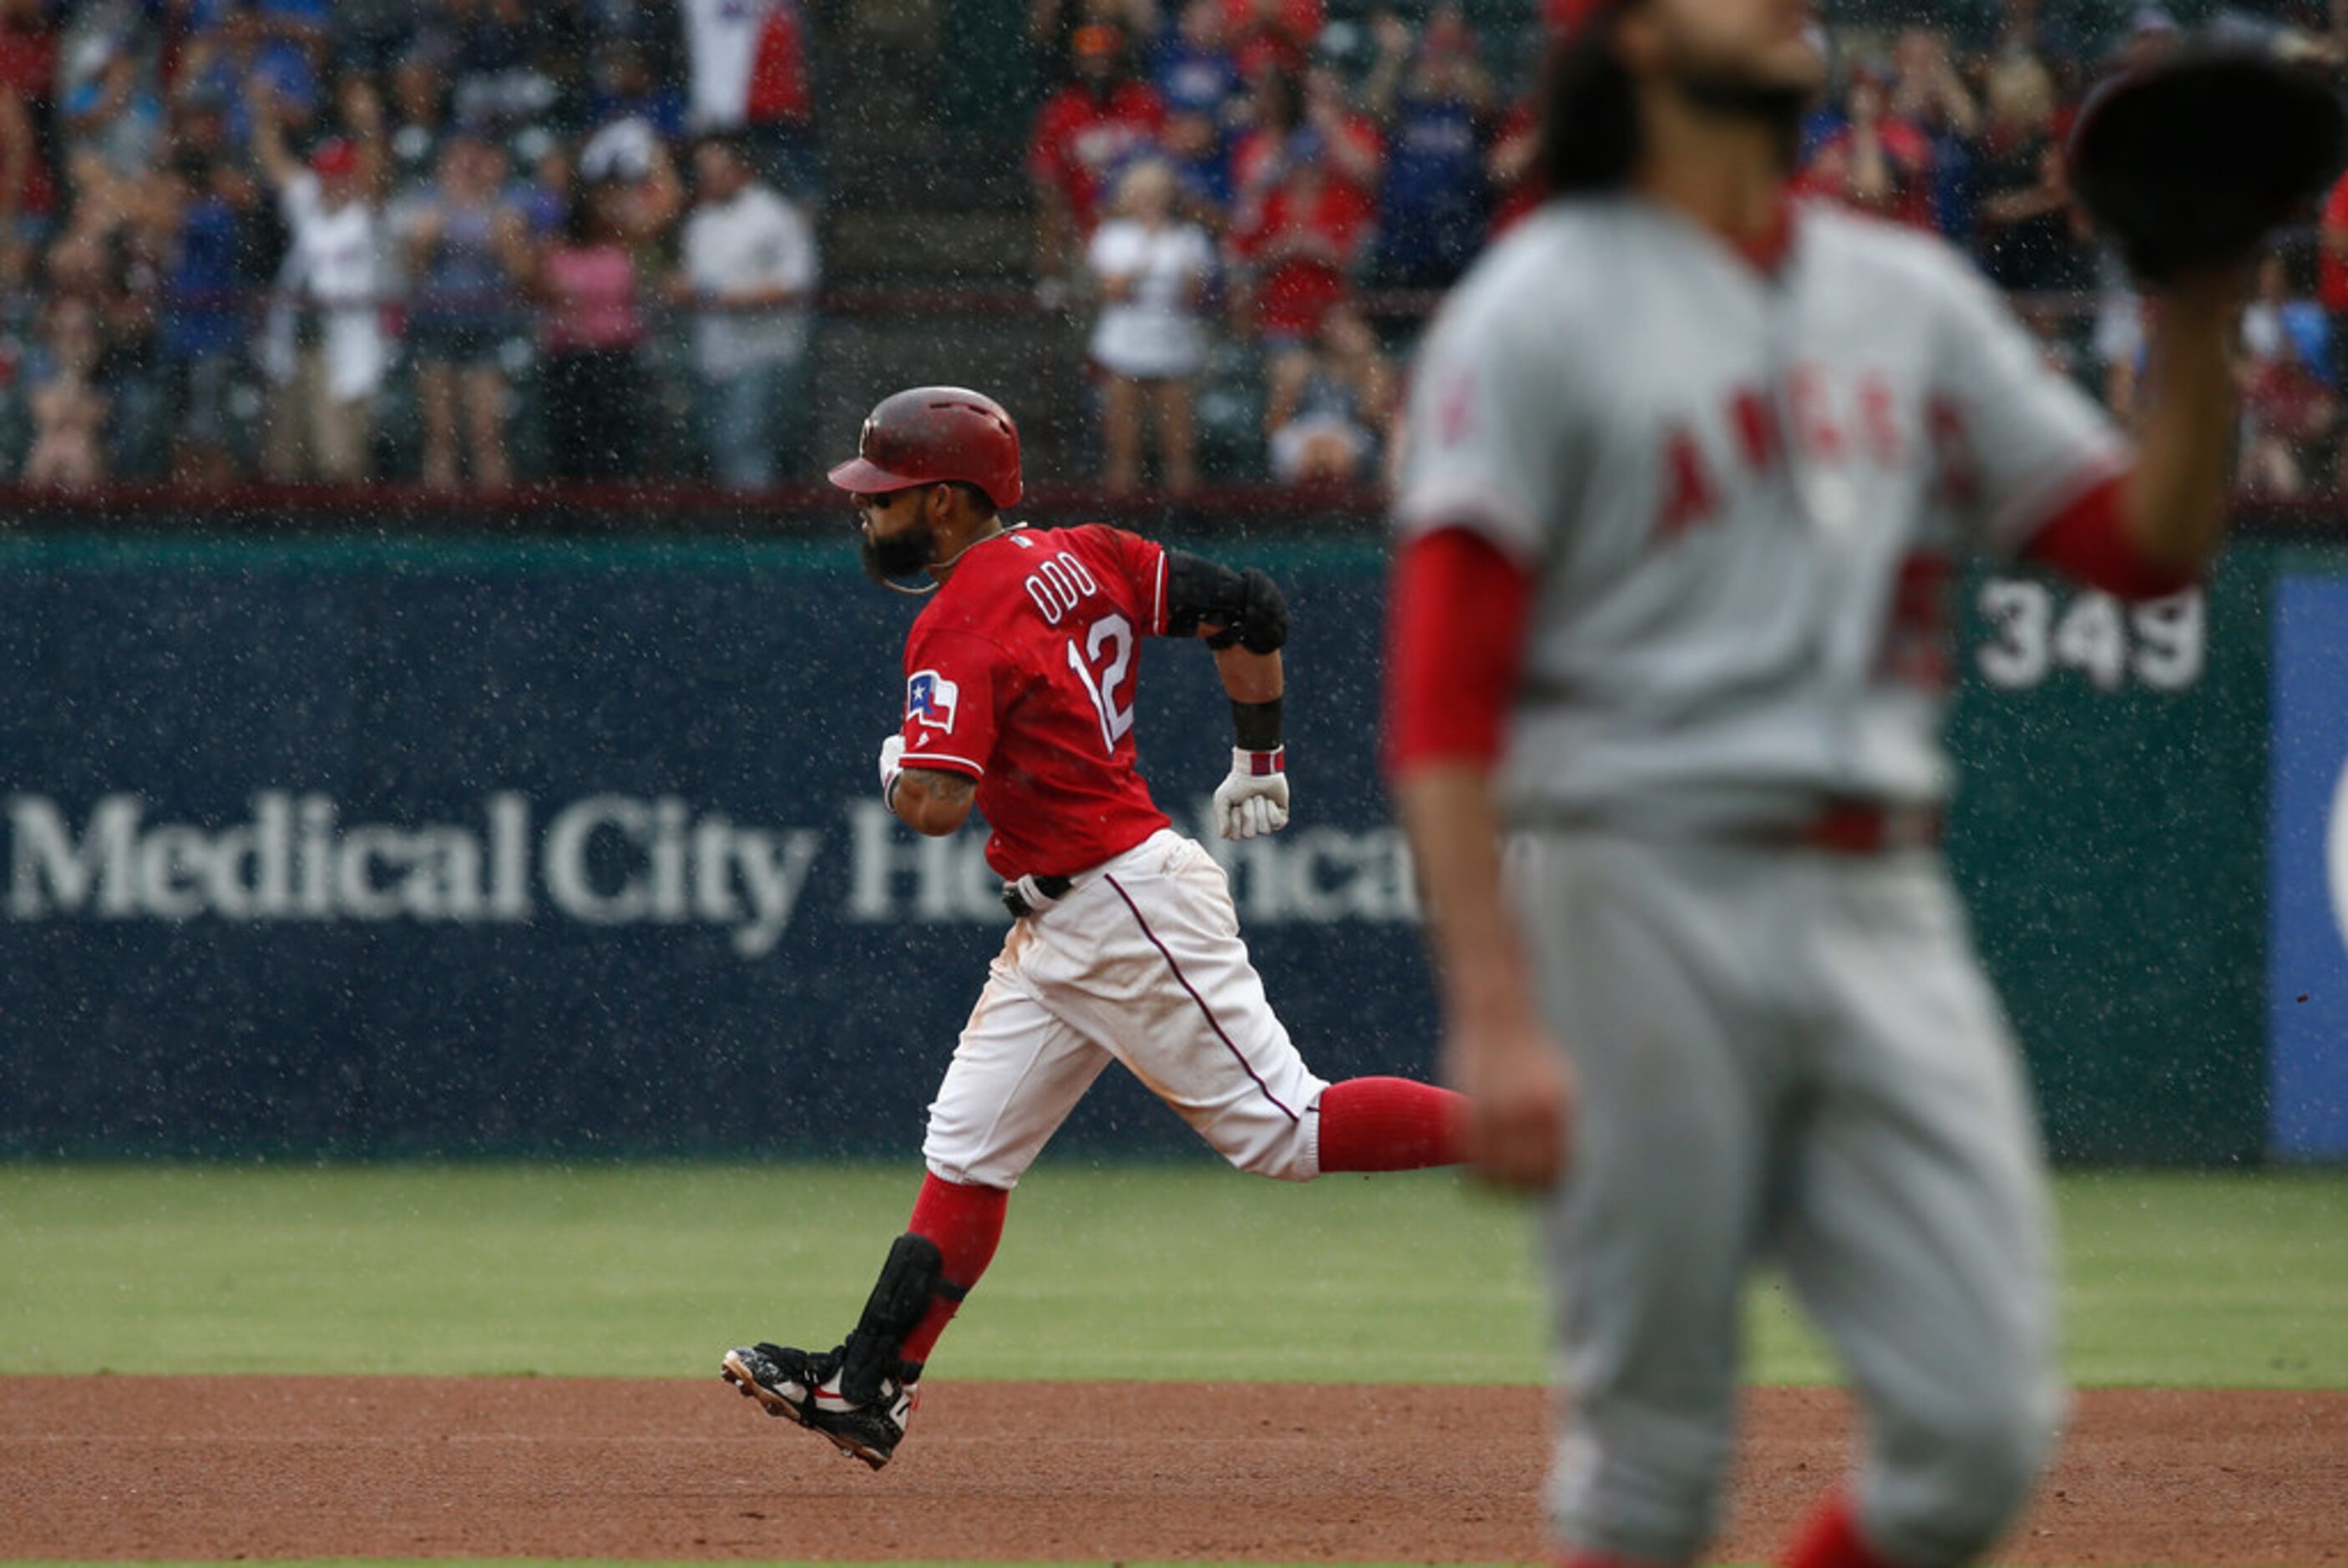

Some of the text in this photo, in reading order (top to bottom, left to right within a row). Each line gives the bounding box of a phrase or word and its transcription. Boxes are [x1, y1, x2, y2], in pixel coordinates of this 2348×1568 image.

[1066, 612, 1134, 754] 12
[1976, 580, 2207, 692] 349
[8, 792, 531, 921] Medical
[545, 792, 821, 957] City
